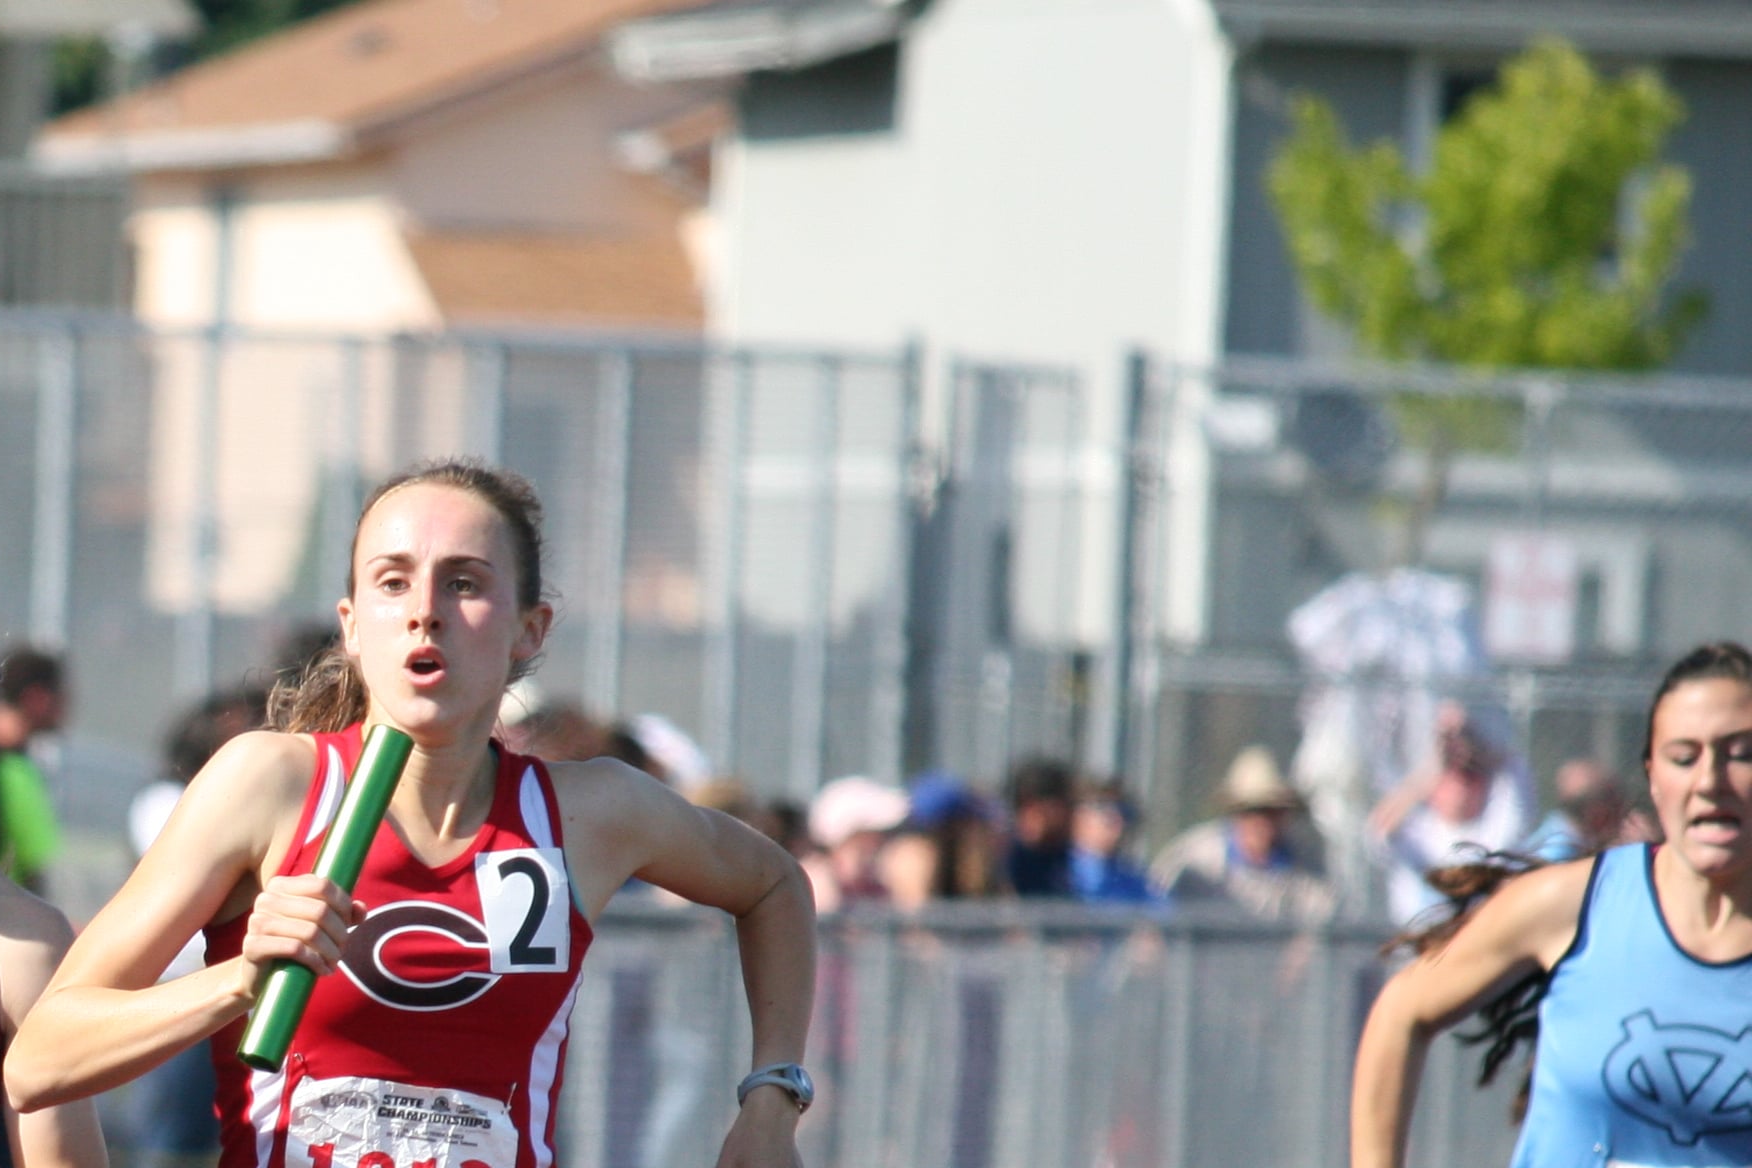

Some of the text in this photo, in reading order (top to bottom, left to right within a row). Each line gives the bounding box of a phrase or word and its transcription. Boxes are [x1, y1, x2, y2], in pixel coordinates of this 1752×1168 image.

[498, 856, 556, 966] 2
[333, 899, 502, 1012] C
[377, 1106, 492, 1129] CHAMPIONSHIPS
[382, 1093, 425, 1109] STATE
